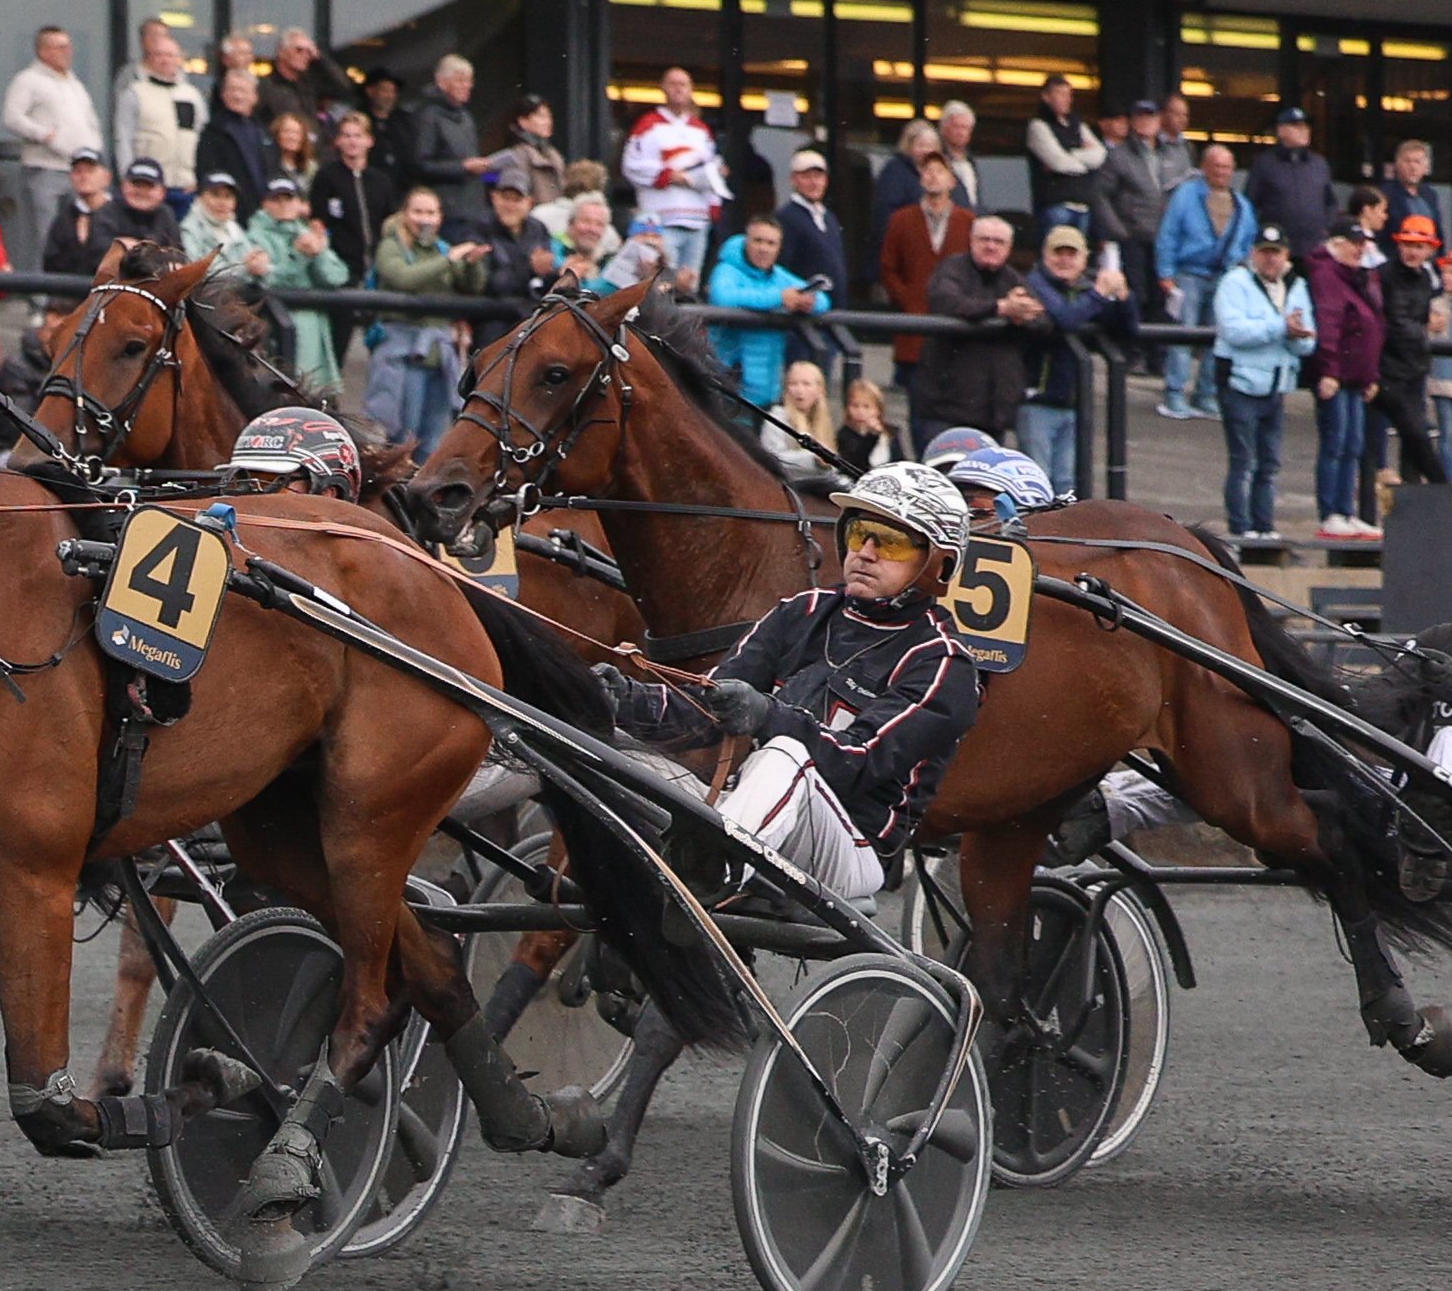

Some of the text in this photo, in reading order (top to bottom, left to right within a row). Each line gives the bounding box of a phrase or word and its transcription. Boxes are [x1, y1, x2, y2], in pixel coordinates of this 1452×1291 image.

[128, 523, 201, 629] 4
[954, 541, 1014, 632] 5
[128, 635, 182, 670] Megaflis
[968, 645, 1008, 663] egaflis
